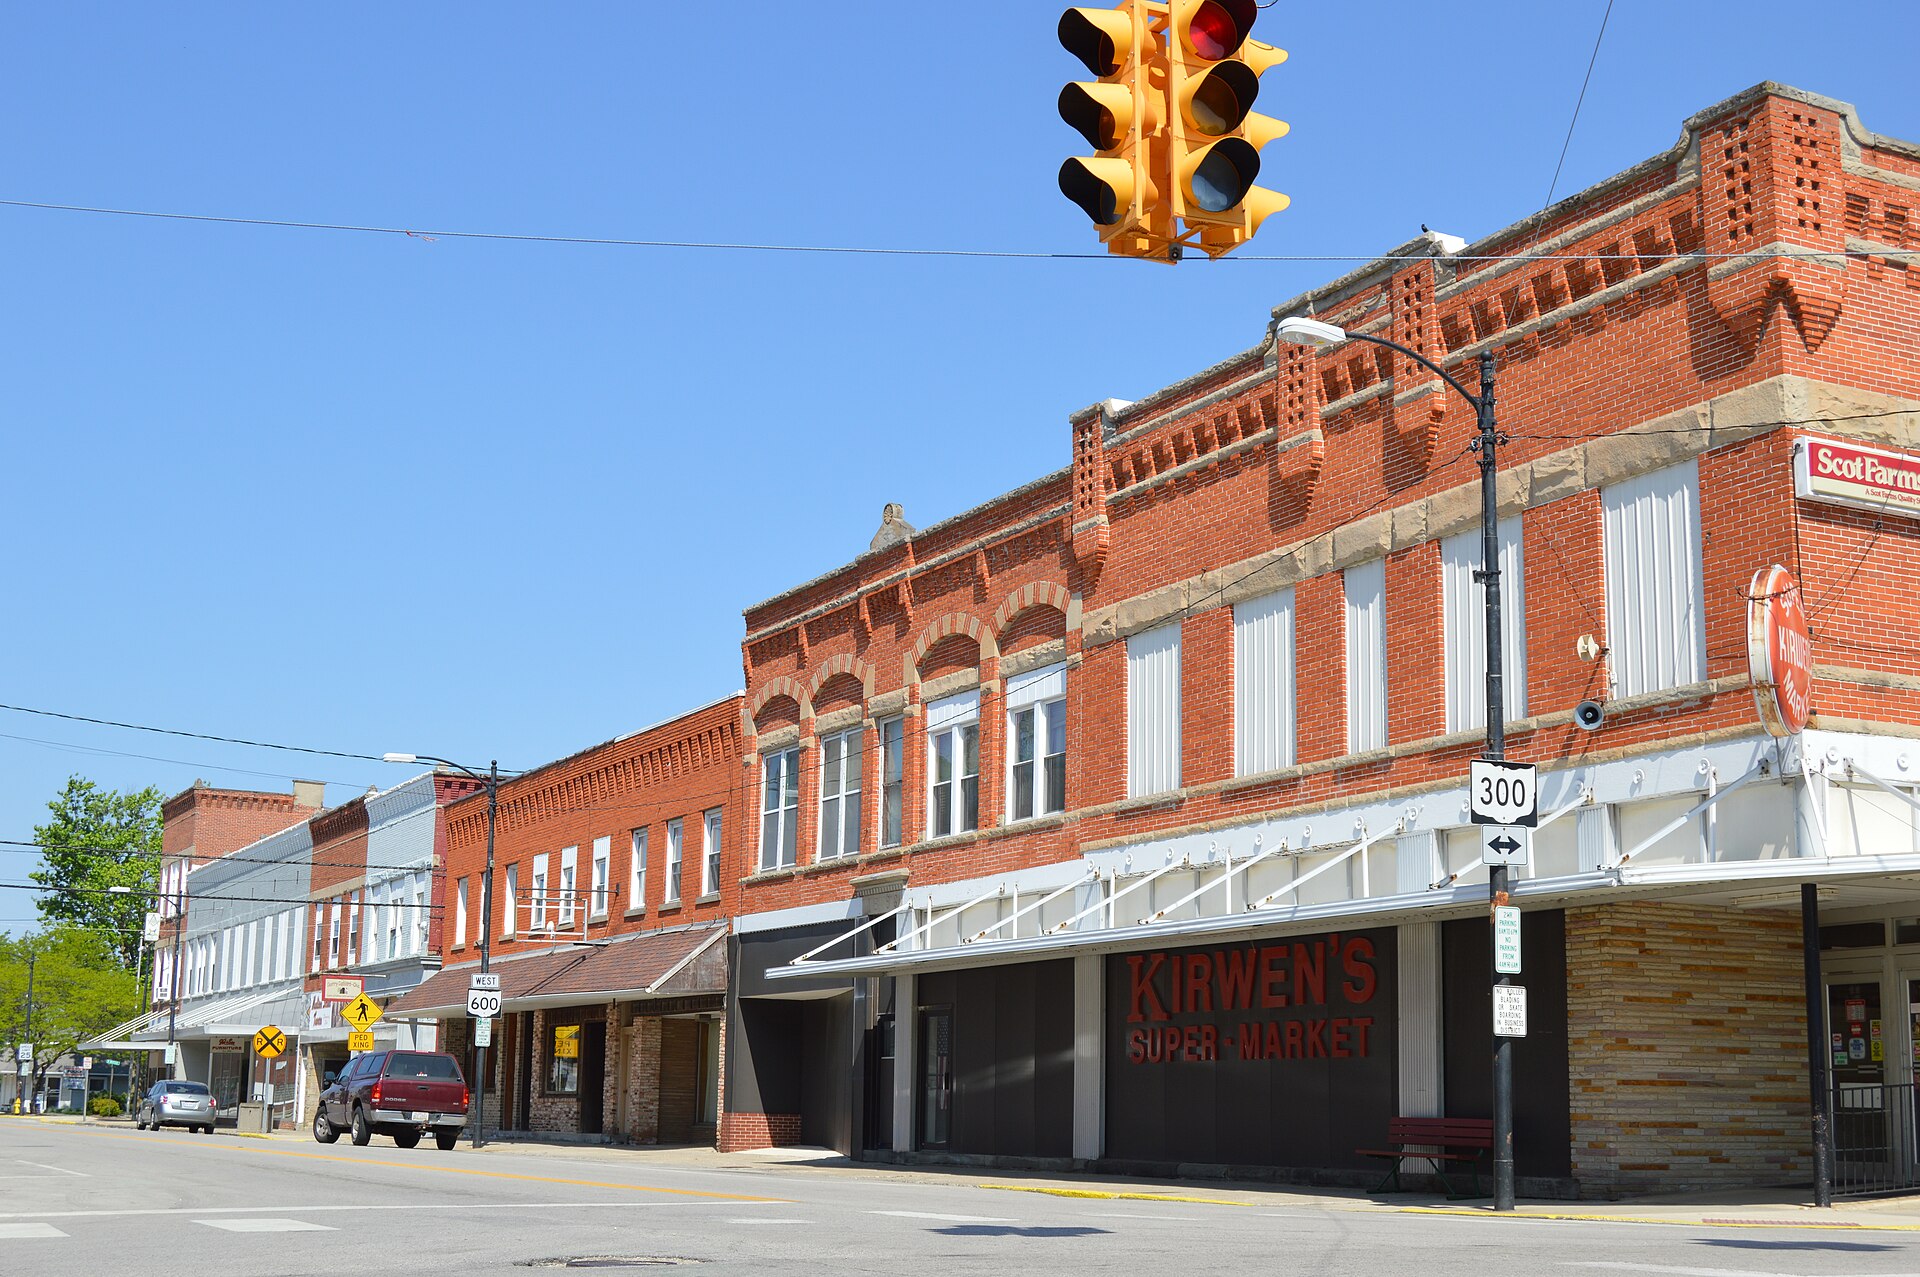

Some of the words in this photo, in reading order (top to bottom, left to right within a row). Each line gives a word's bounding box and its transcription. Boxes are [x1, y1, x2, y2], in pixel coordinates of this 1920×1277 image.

[1870, 489, 1881, 497] Scot
[1882, 491, 1897, 500] Farms
[1898, 494, 1916, 505] Quality
[1480, 776, 1525, 808] 300
[475, 976, 496, 986] WEST
[1126, 933, 1377, 1023] KIRWEN'S
[471, 997, 498, 1010] 600
[256, 1038, 263, 1046] R
[1129, 1024, 1217, 1065] SUPER
[1239, 1017, 1374, 1060] MARKET
